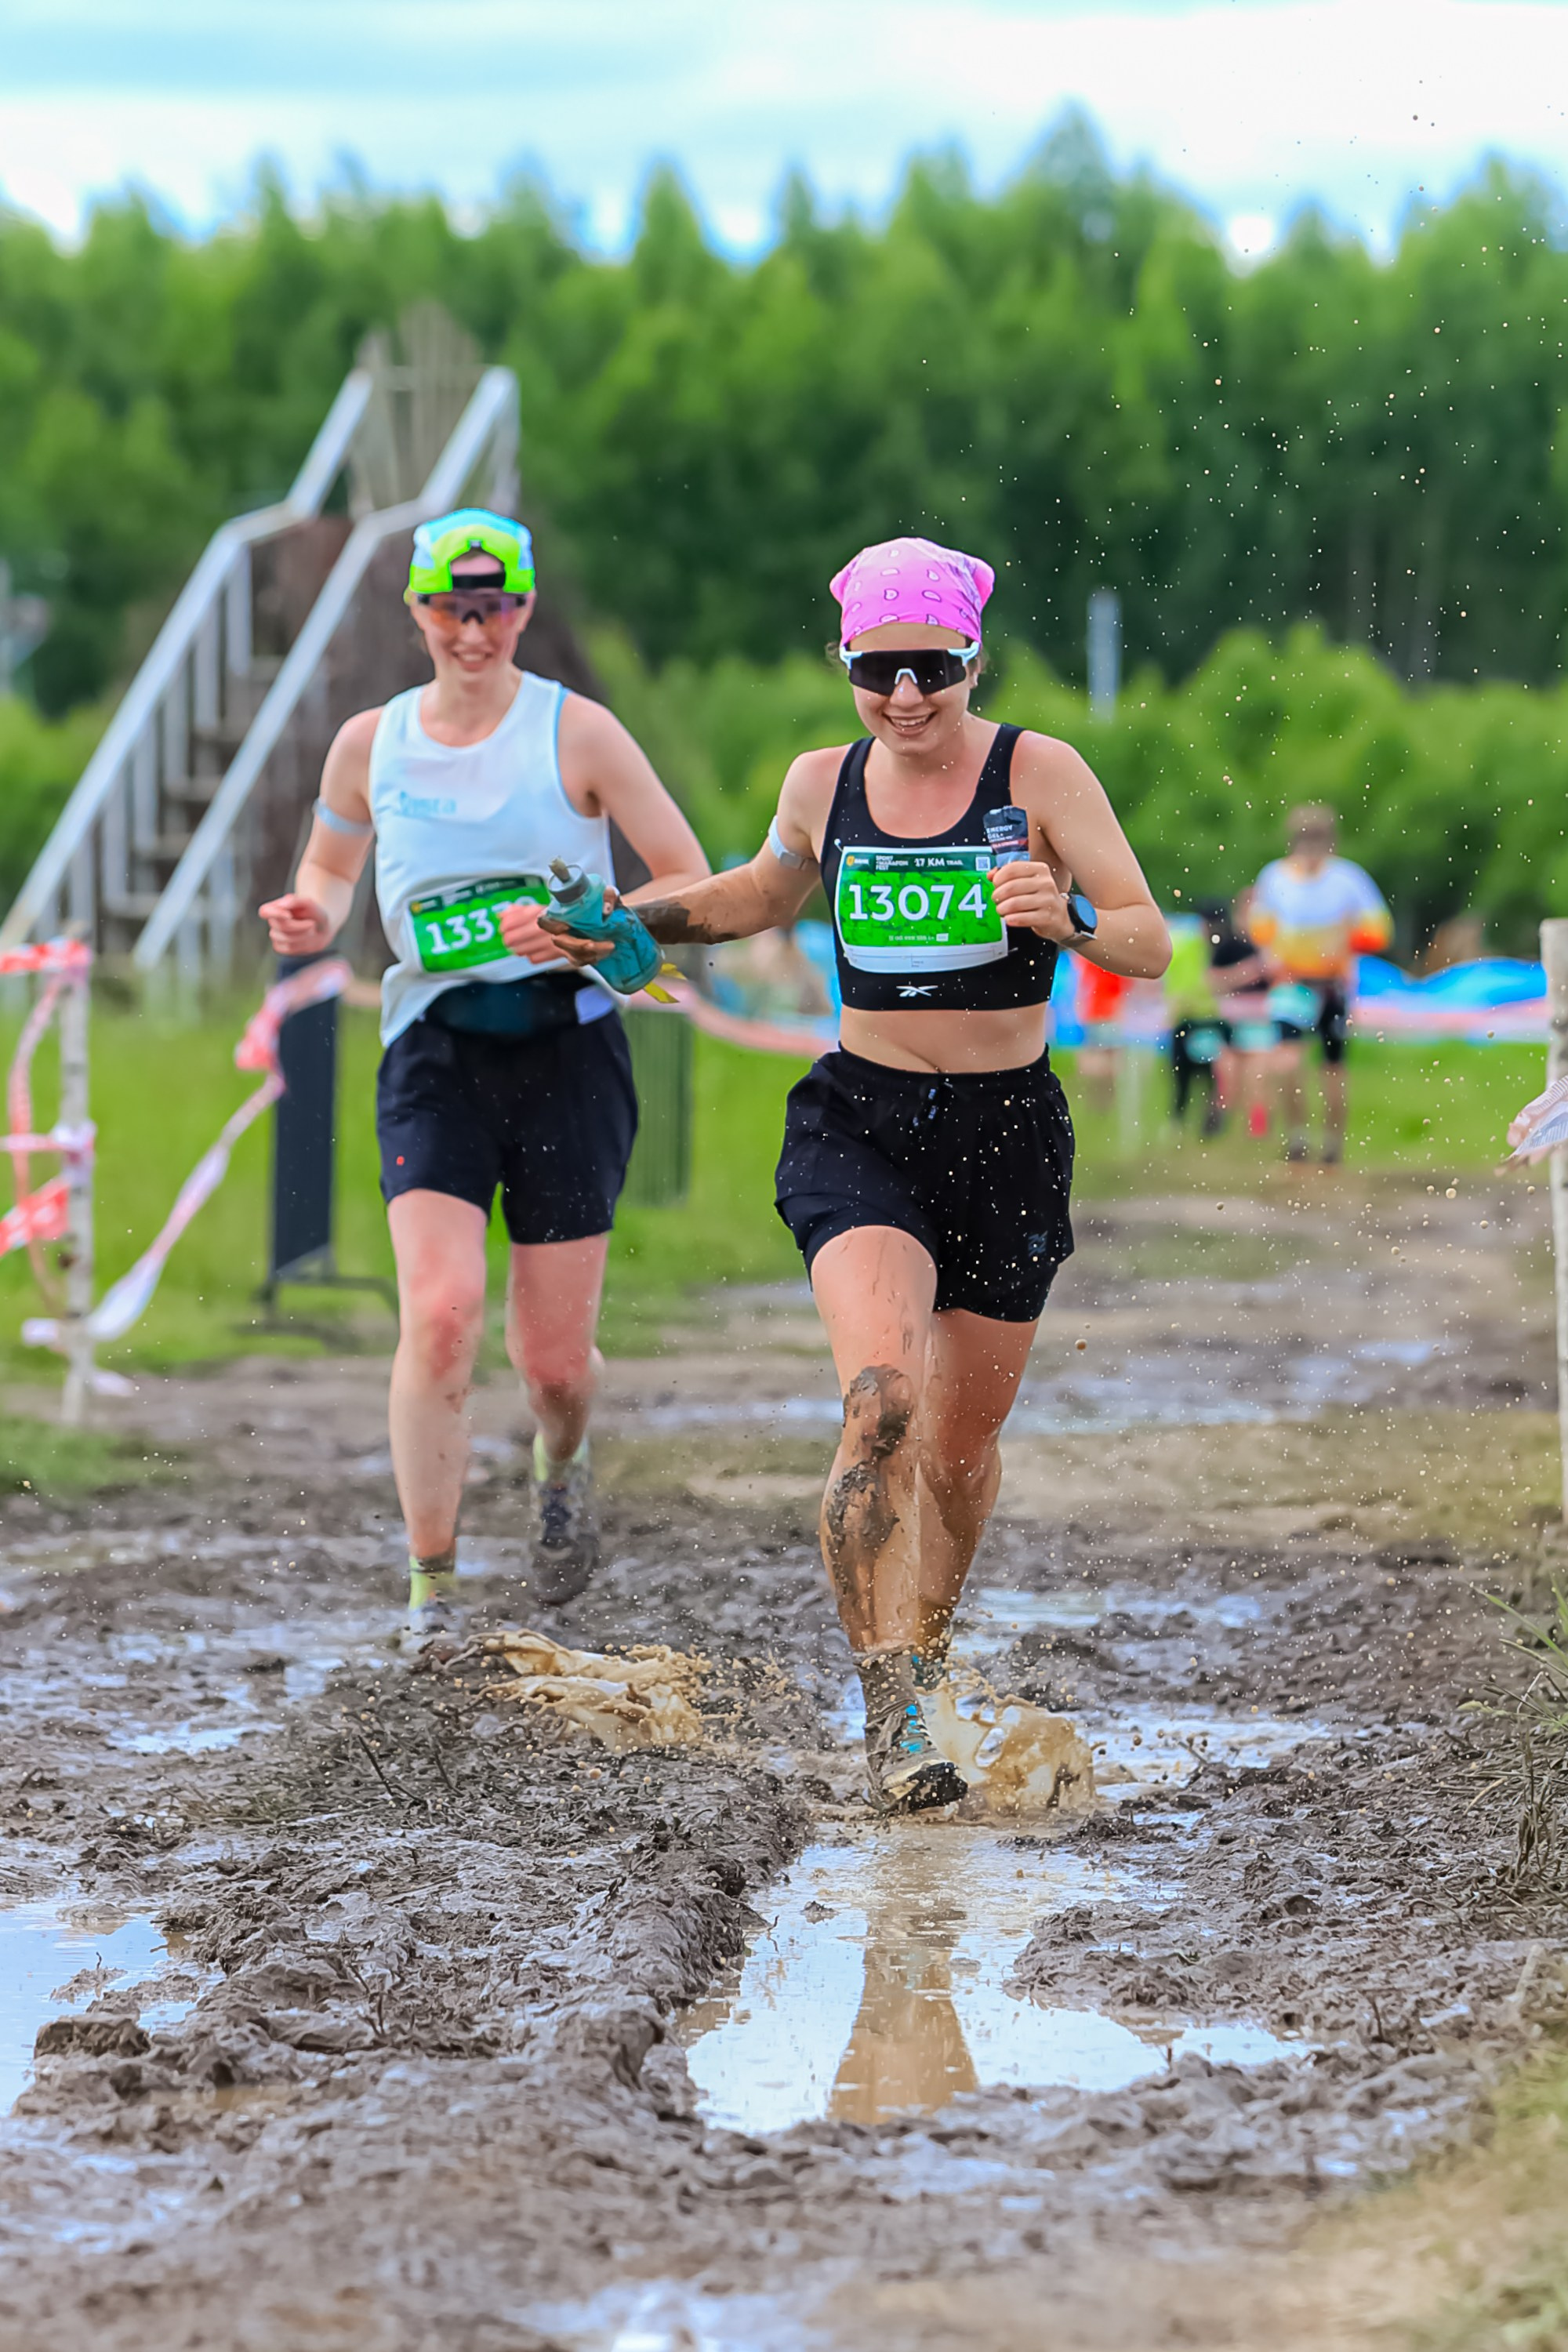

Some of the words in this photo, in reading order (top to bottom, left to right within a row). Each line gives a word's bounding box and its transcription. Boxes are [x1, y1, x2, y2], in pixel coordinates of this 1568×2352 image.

[914, 858, 925, 867] 17
[927, 858, 945, 867] KM
[848, 884, 987, 921] 13074
[426, 896, 538, 954] 133
